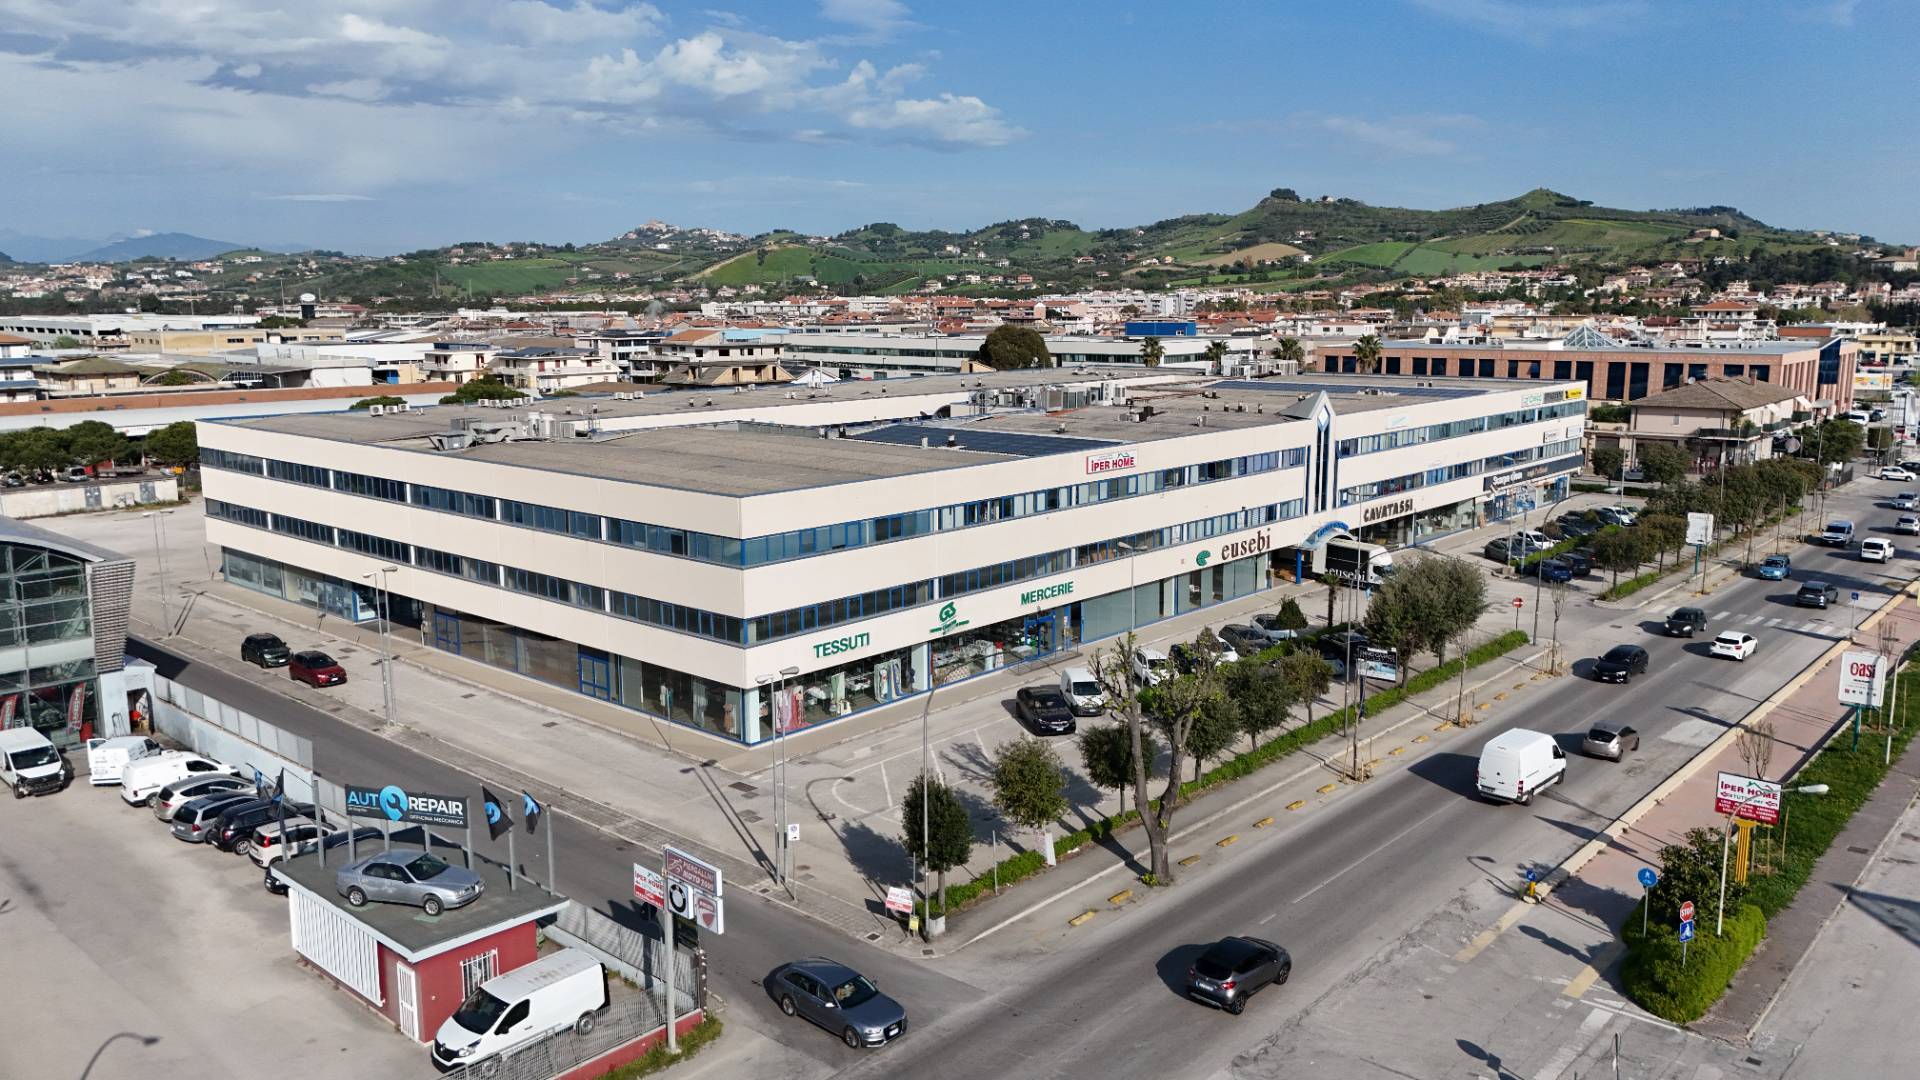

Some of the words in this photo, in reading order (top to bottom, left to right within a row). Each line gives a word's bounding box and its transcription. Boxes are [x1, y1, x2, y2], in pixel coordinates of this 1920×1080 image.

[1112, 457, 1135, 468] HOME
[1363, 498, 1413, 522] CAVATASSI
[1221, 527, 1271, 560] eusebi
[1020, 581, 1074, 605] MERCERIE
[813, 632, 870, 659] TESSUTI
[1747, 788, 1778, 801] HOME
[407, 796, 464, 816] REPAIR
[433, 816, 464, 825] MECCANICA
[1681, 906, 1694, 915] STOP
